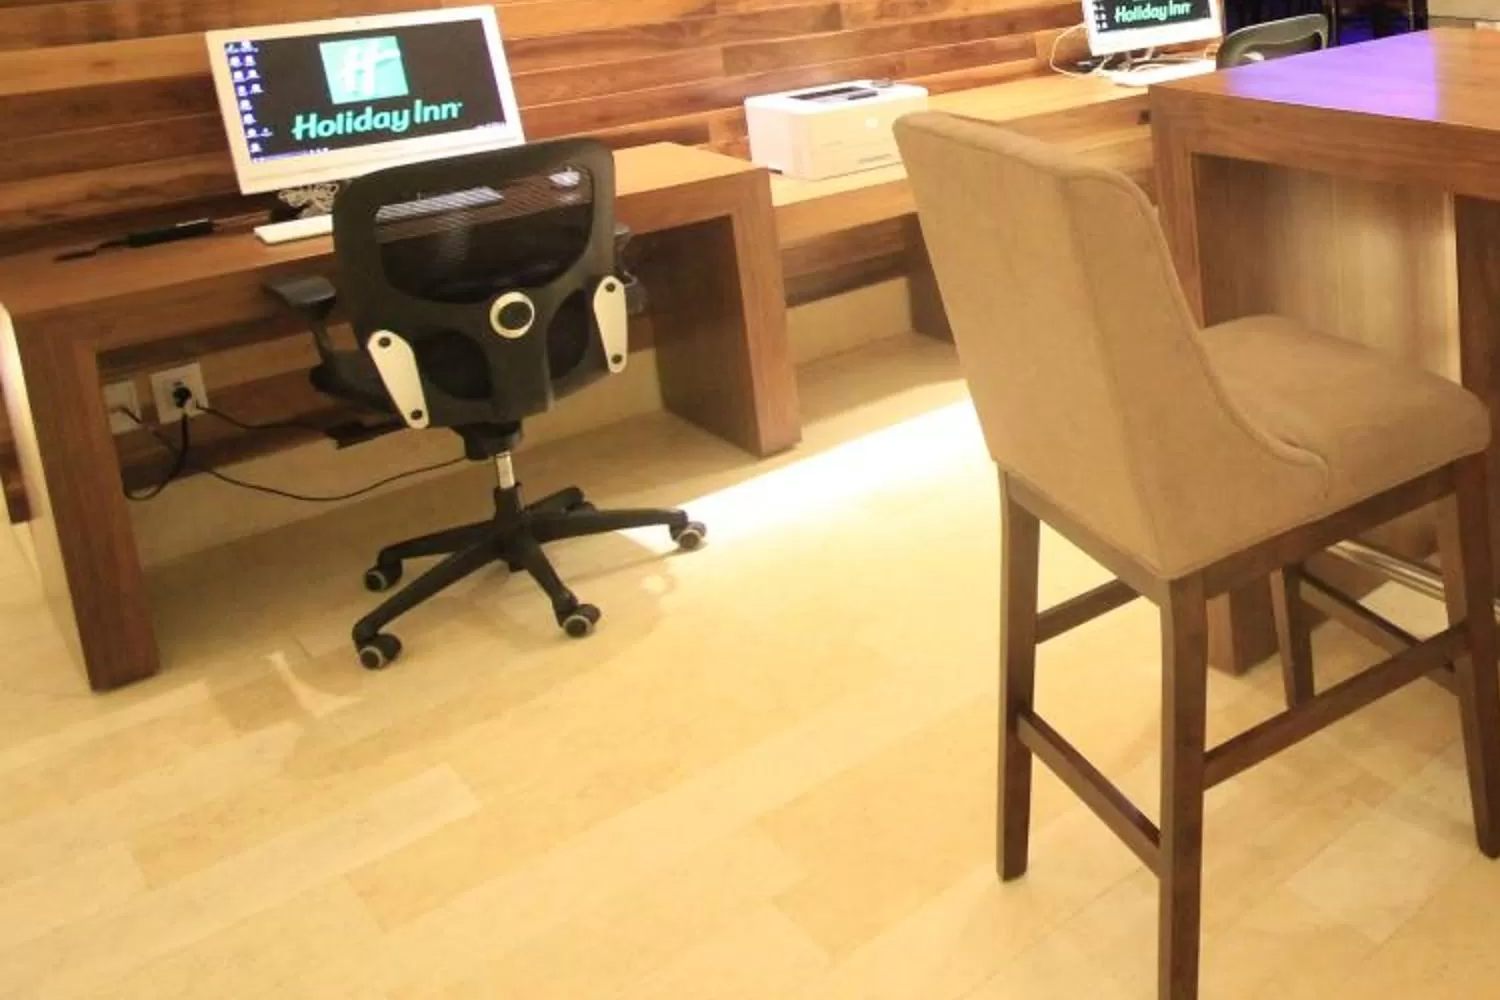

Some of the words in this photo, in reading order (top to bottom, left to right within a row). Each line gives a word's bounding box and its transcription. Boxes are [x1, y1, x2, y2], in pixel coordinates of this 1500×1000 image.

[1114, 2, 1167, 23] Holiday
[1168, 0, 1193, 16] Inn
[291, 107, 410, 140] Holiday
[412, 99, 462, 124] Inn
